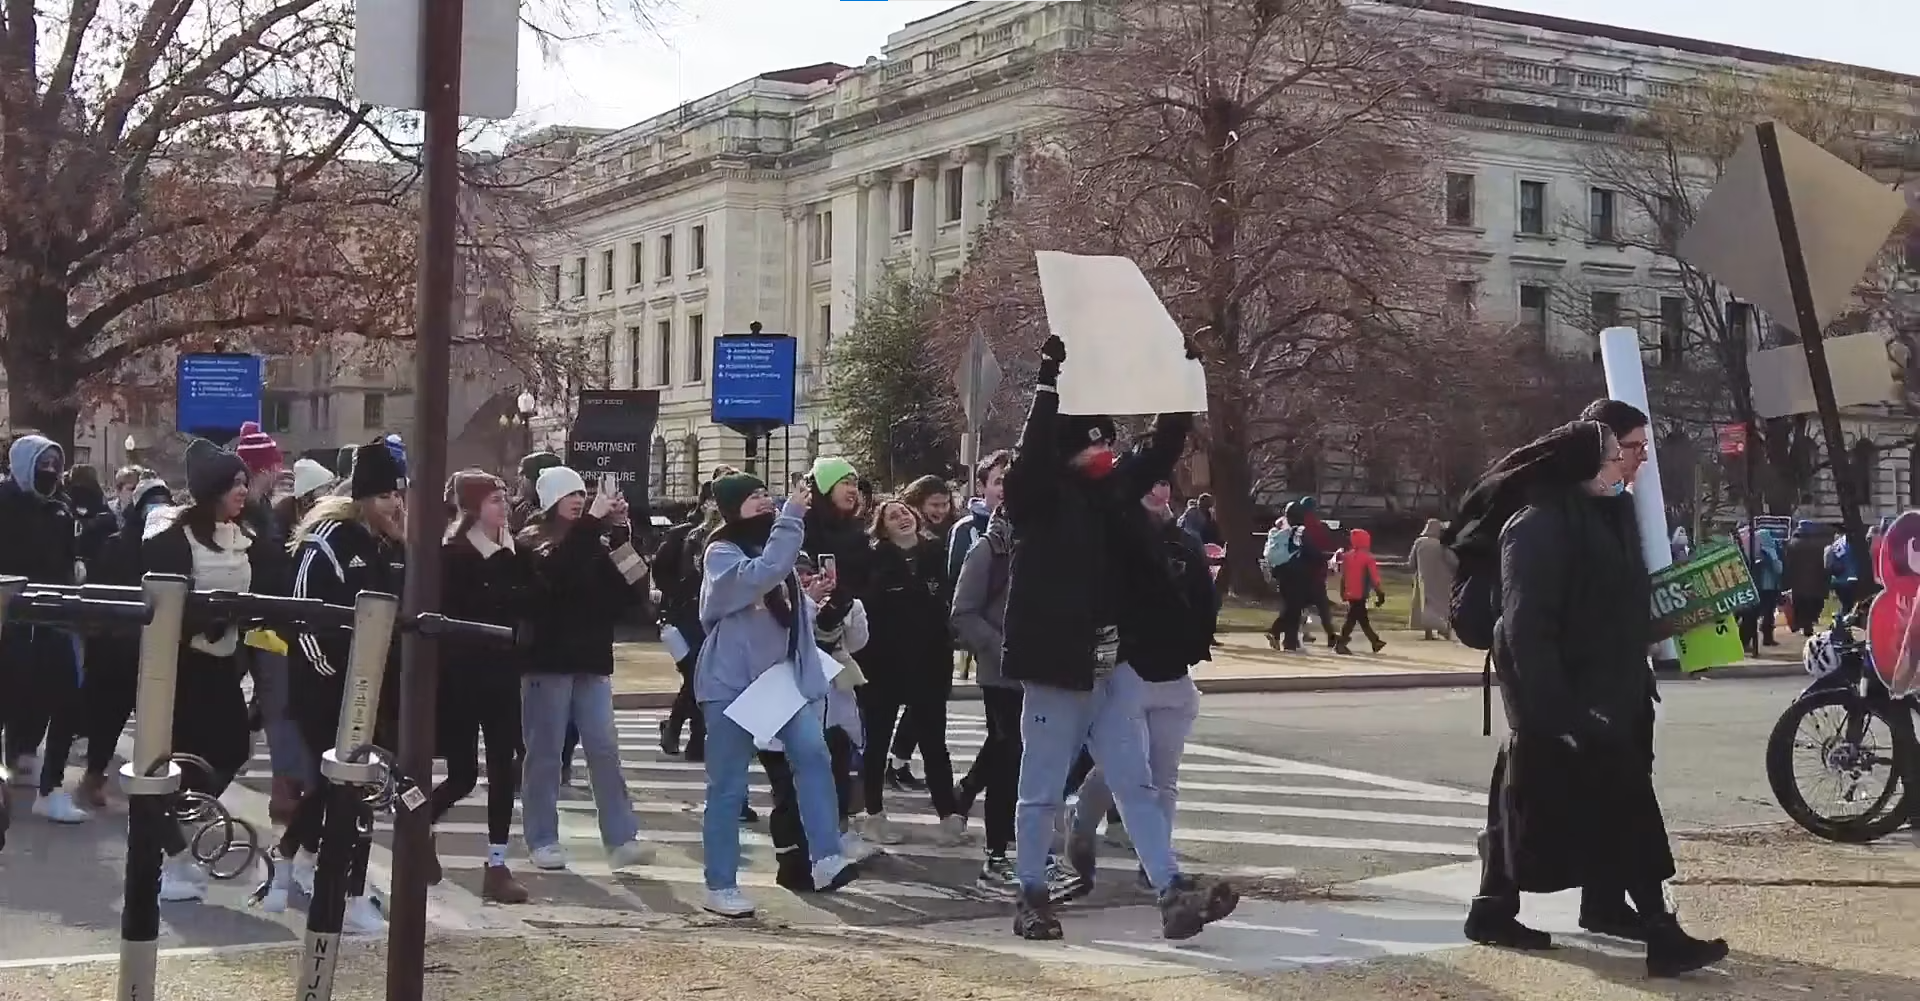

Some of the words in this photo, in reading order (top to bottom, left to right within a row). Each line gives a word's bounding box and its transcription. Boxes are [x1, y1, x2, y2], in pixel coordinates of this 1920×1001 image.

[573, 442, 637, 452] DEPARTMENT
[597, 456, 611, 466] OF
[1715, 588, 1755, 613] LIVES
